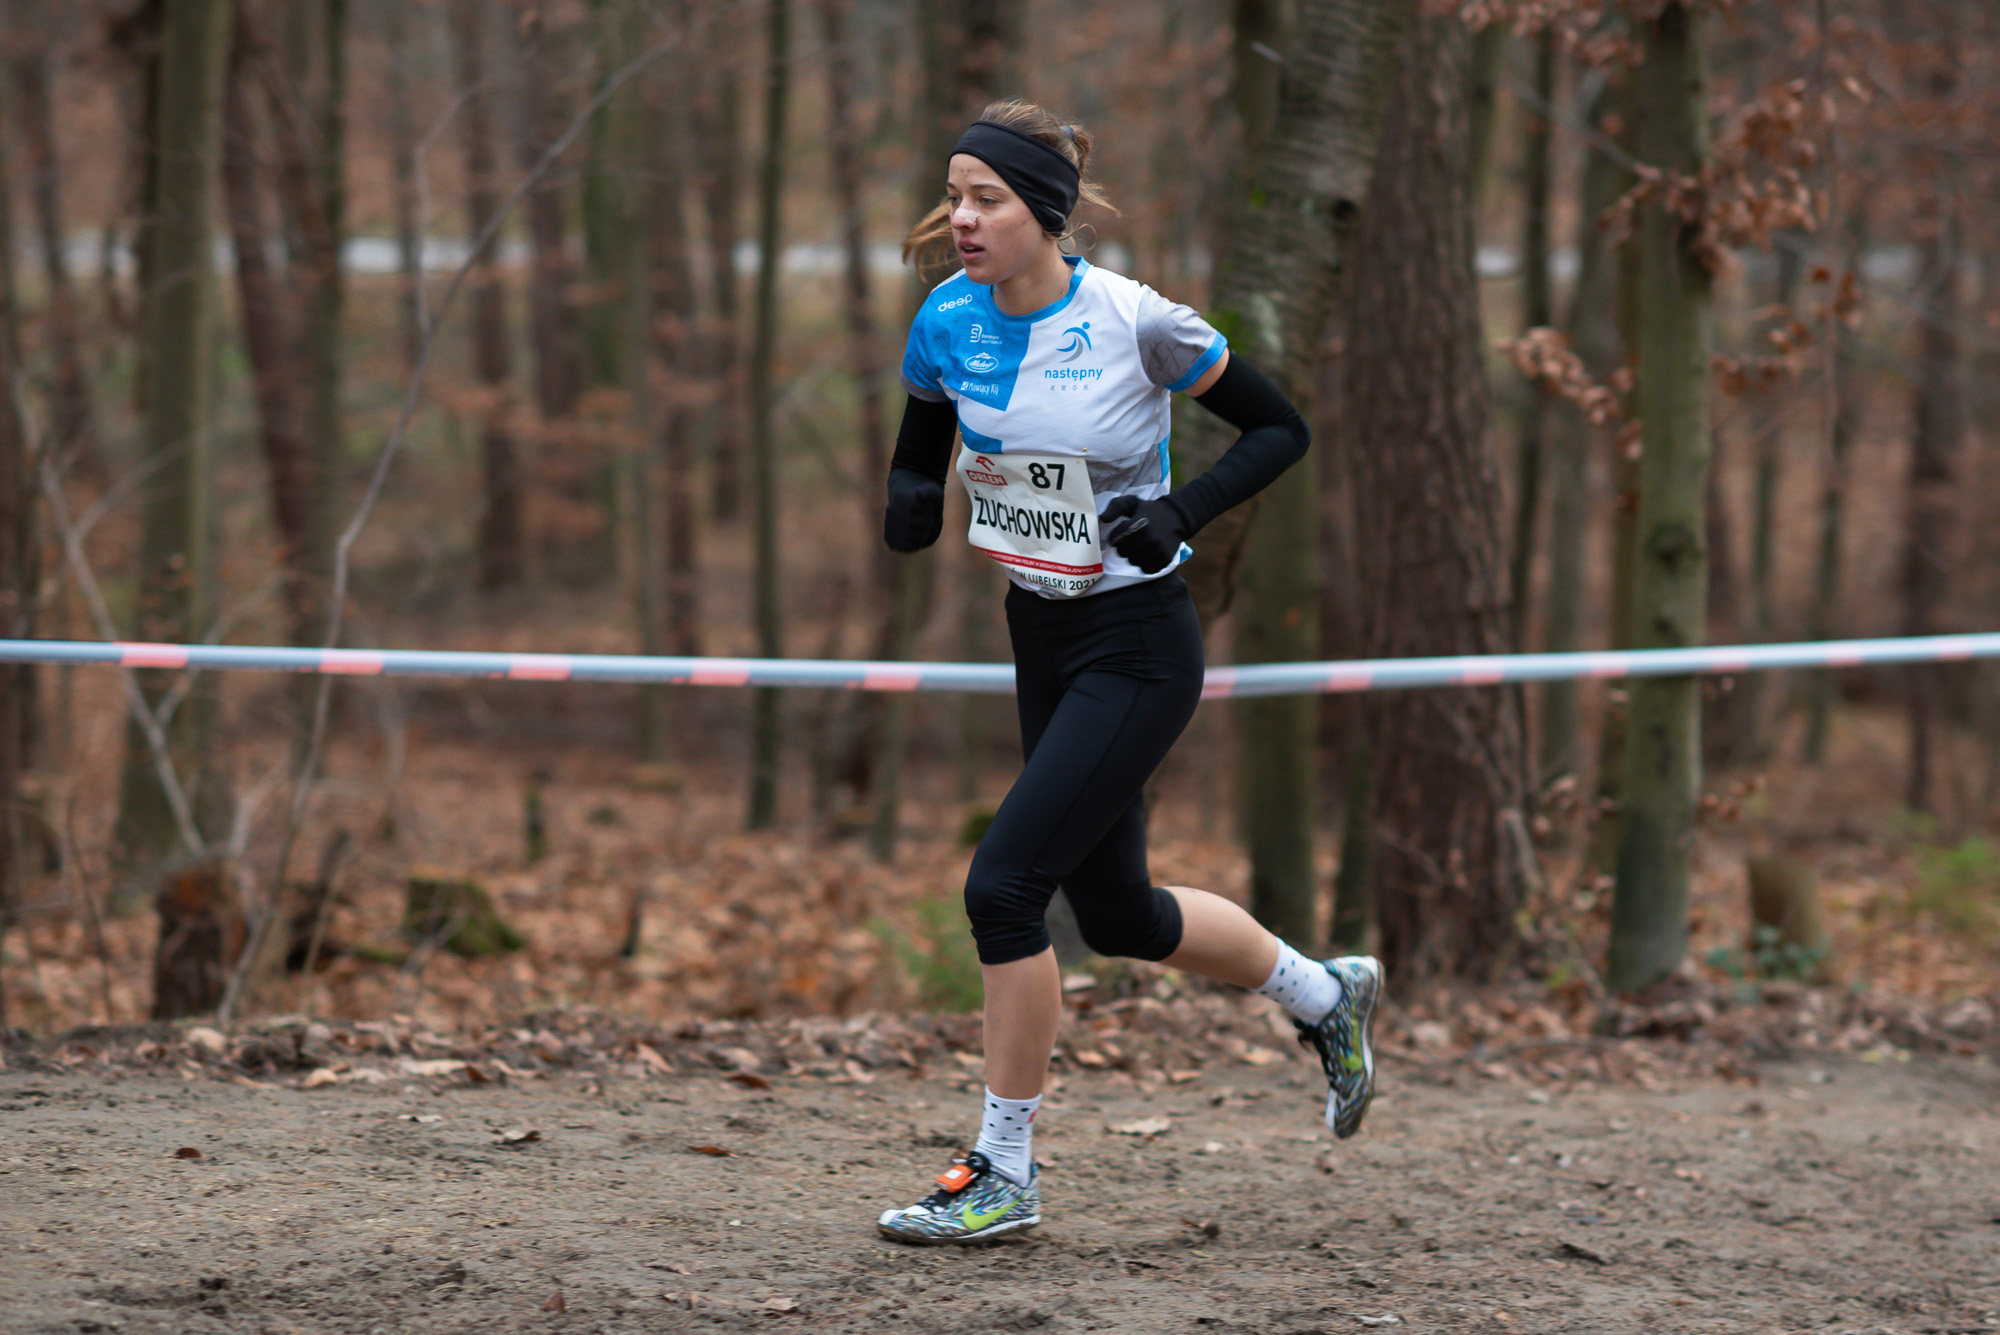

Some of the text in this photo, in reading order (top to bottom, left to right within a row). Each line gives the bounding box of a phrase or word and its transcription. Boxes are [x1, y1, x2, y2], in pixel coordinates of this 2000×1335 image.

[937, 294, 973, 312] deep
[1044, 367, 1103, 381] następny
[1050, 384, 1089, 392] KROK
[969, 472, 1006, 485] ORLEN
[1028, 462, 1065, 491] 87
[974, 490, 1091, 545] ŻUCHOWSKA
[1028, 573, 1066, 590] LUBELSKI
